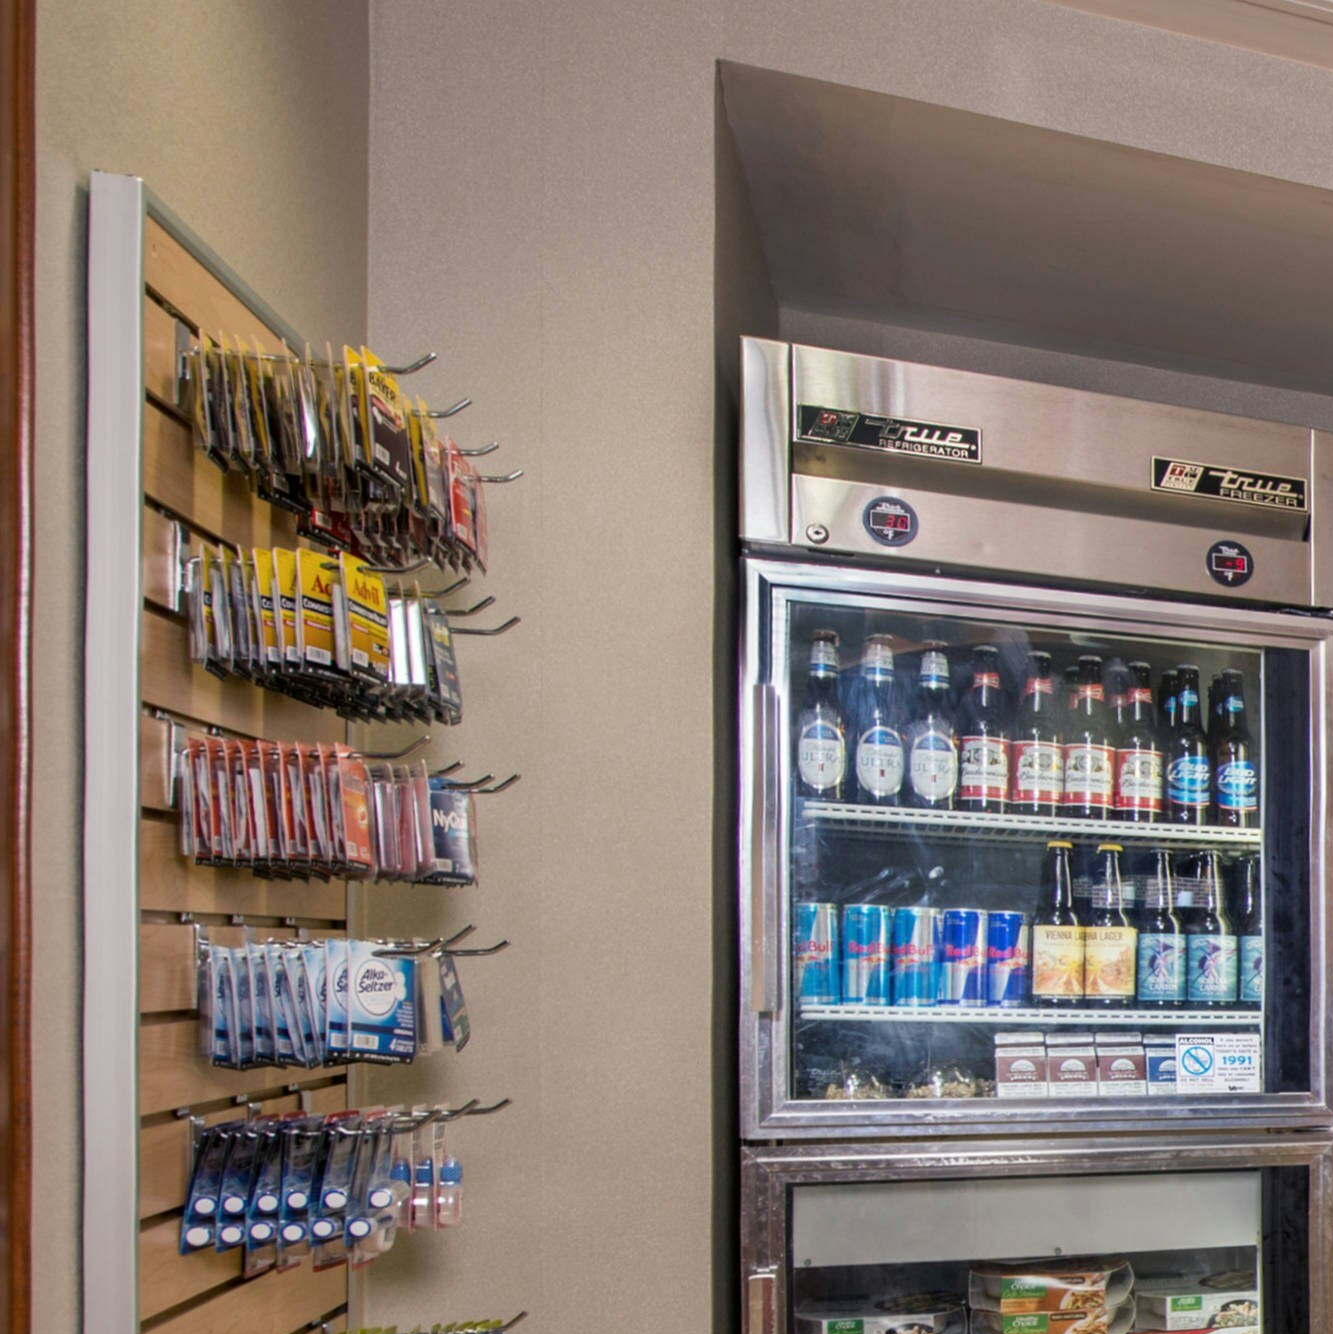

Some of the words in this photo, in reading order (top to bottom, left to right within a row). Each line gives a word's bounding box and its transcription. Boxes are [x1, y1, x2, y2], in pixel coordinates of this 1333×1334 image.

[865, 417, 970, 448] true
[879, 439, 969, 458] REFRIGERATOR
[1209, 470, 1298, 497] true
[1220, 488, 1297, 506] FREEZER
[353, 578, 381, 607] Advil
[1181, 760, 1208, 772] BUD
[1225, 765, 1255, 777] BUD
[1173, 768, 1210, 781] LIGHT
[1218, 773, 1257, 786] LIGHT
[1045, 930, 1072, 941] VIENNA
[1100, 931, 1123, 941] LAGER
[361, 968, 389, 980] Alka-
[358, 980, 396, 993] Seltzer
[1222, 1056, 1252, 1065] 1991
